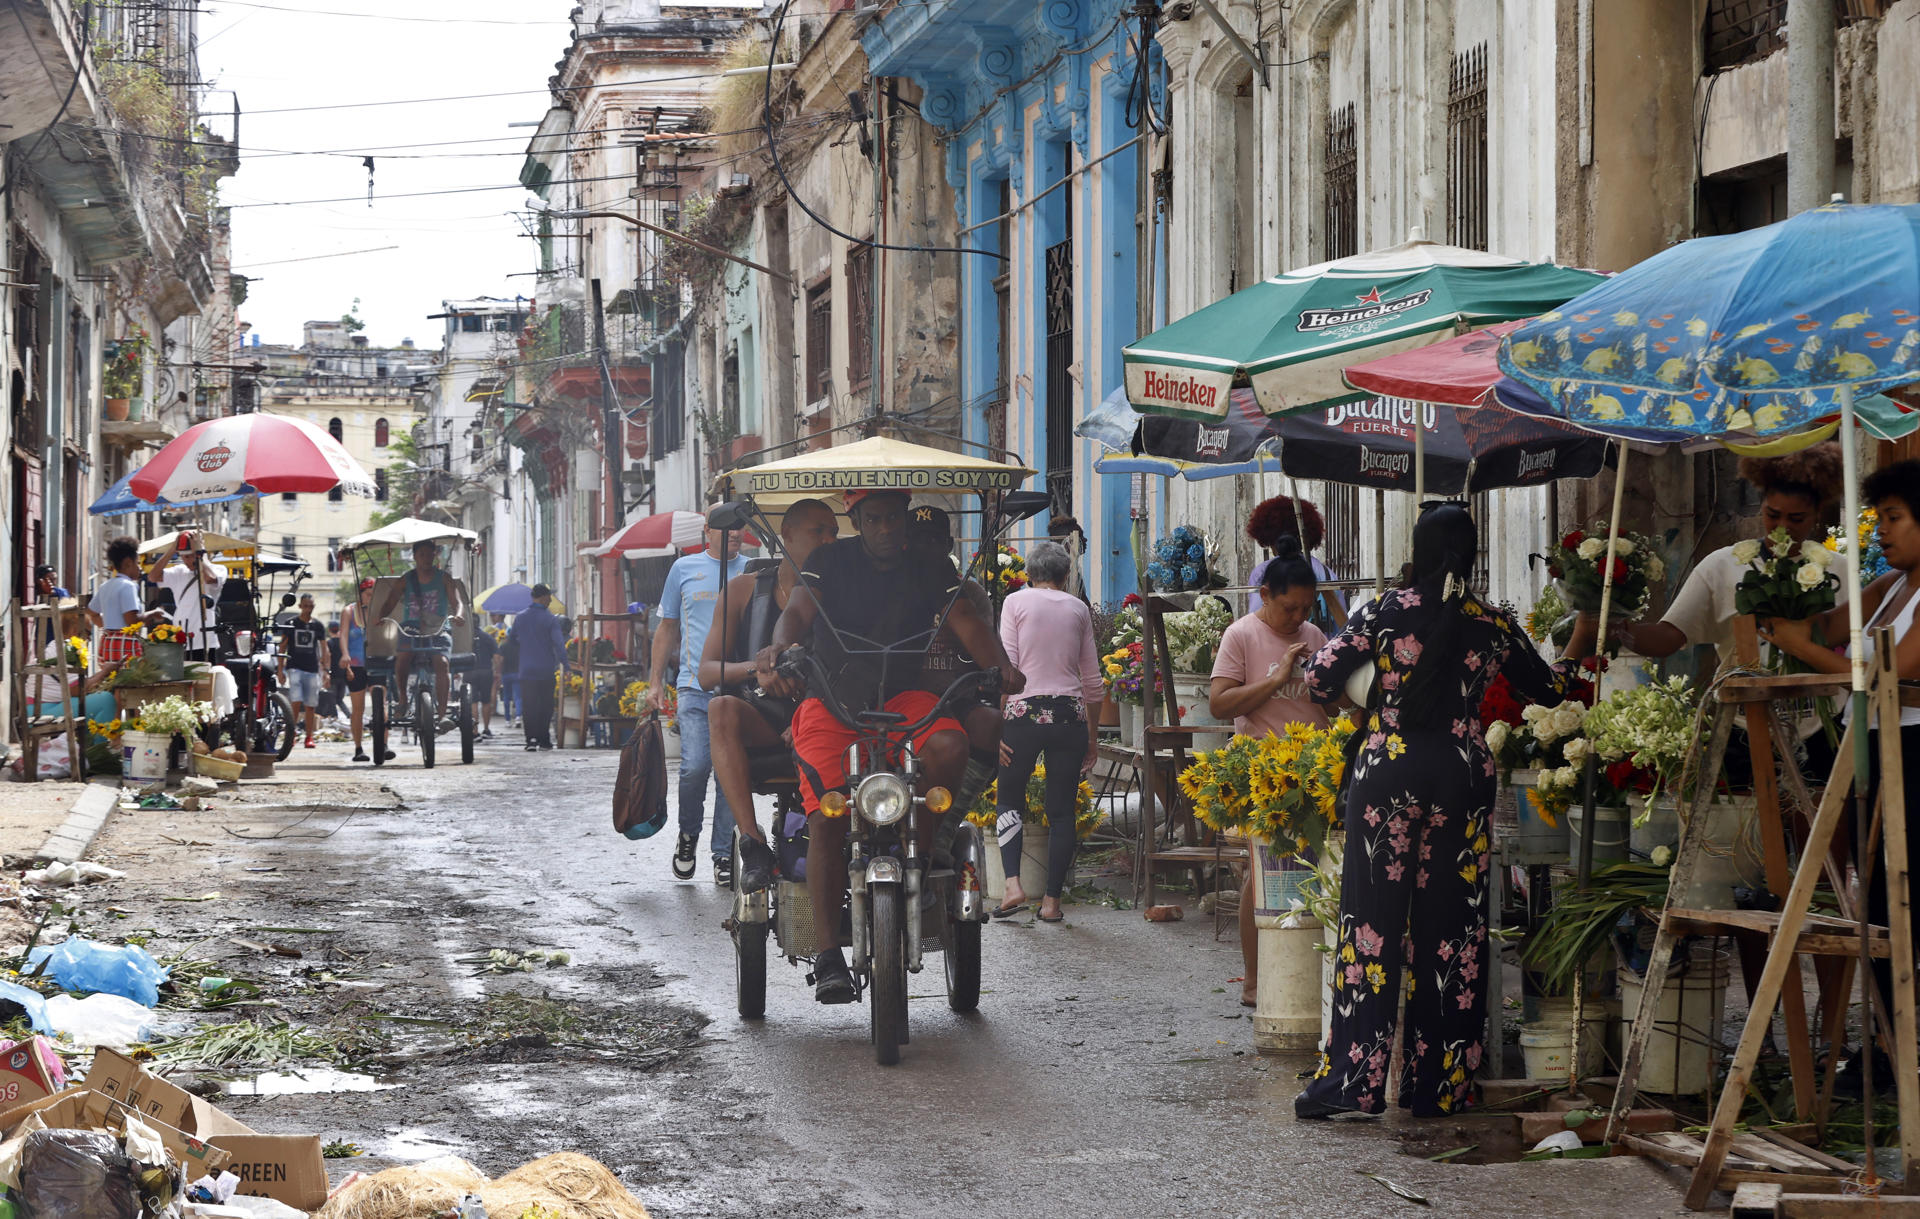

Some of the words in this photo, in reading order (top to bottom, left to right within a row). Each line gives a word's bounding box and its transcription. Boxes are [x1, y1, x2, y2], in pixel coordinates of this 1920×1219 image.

[1307, 294, 1421, 328] Heineken
[1143, 370, 1217, 408] Heineken
[1196, 422, 1230, 453] Bucanero
[1353, 422, 1408, 437] FUERTE
[195, 451, 236, 462] Havana
[200, 459, 223, 469] Club
[1360, 444, 1409, 474] Bucanero
[1517, 447, 1556, 478] Bucanero
[753, 472, 779, 491] TU
[785, 469, 929, 490] TORMENTO
[935, 469, 984, 489] SOY
[985, 471, 1012, 489] YO
[1370, 470, 1396, 479] FUERTE
